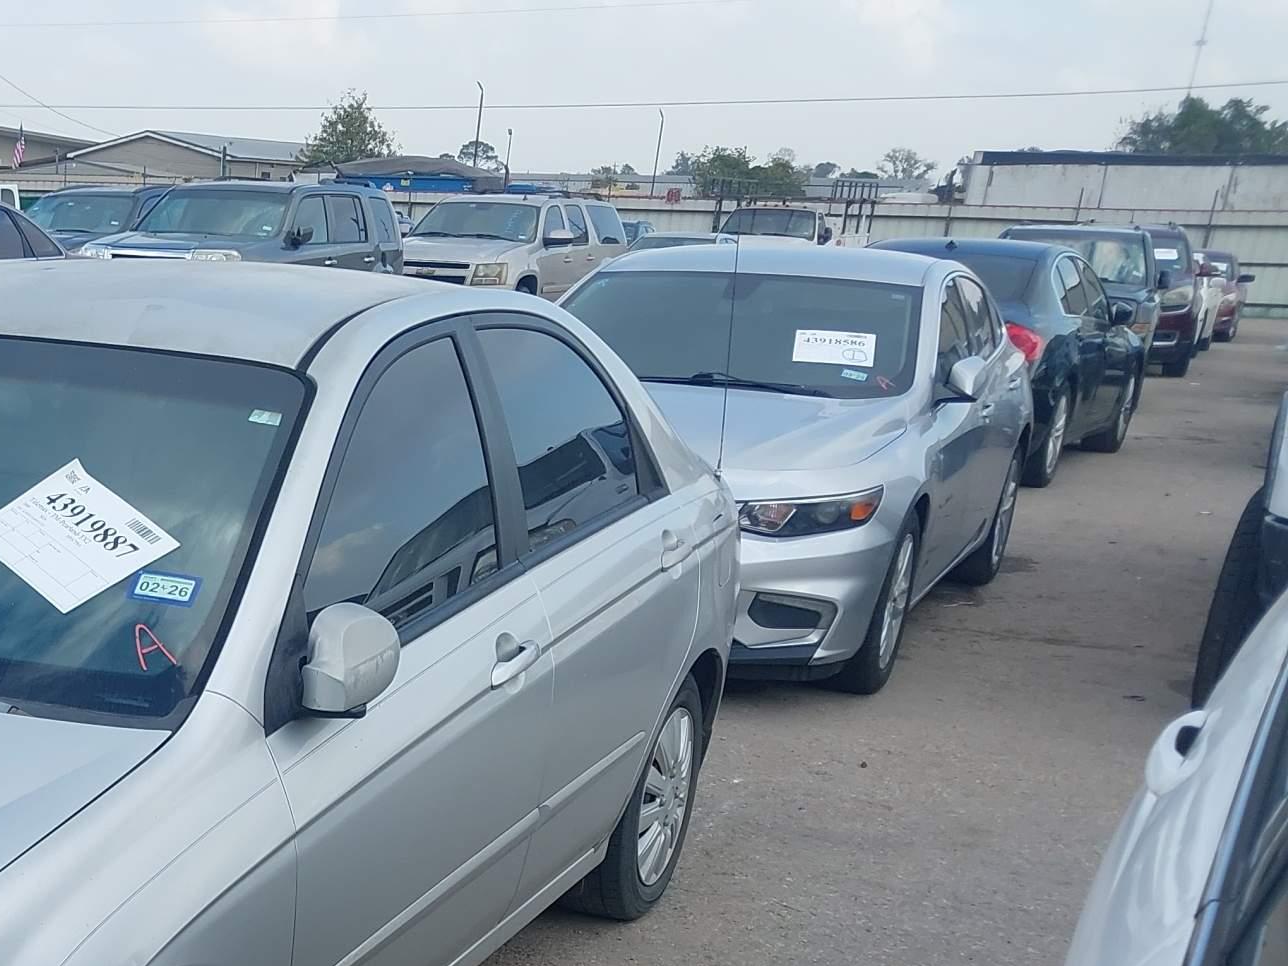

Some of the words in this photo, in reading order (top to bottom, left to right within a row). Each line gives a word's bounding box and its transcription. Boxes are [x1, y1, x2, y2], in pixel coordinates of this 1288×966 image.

[803, 337, 866, 347] 43918586
[46, 493, 140, 558] 43919887
[135, 623, 177, 671] A
